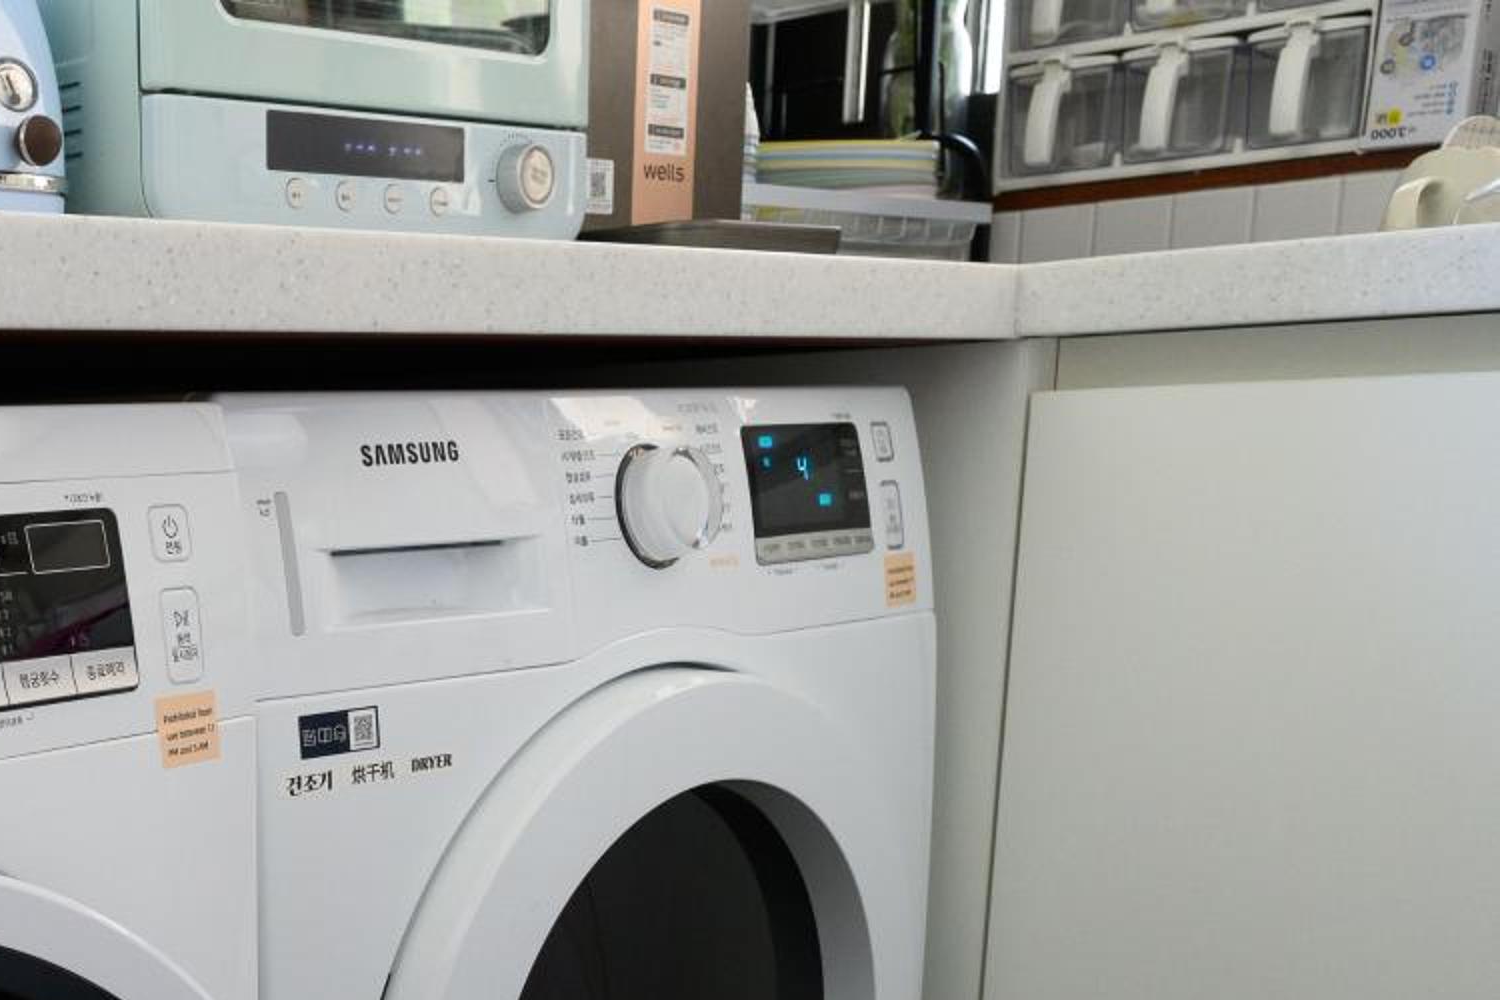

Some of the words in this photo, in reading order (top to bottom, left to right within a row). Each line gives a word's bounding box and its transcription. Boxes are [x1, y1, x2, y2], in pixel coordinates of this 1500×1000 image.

[644, 163, 685, 183] wells
[360, 440, 459, 467] SAMSUNG
[286, 769, 333, 797] 건조기
[351, 760, 395, 785] 烘干机
[411, 753, 453, 773] DRYER
